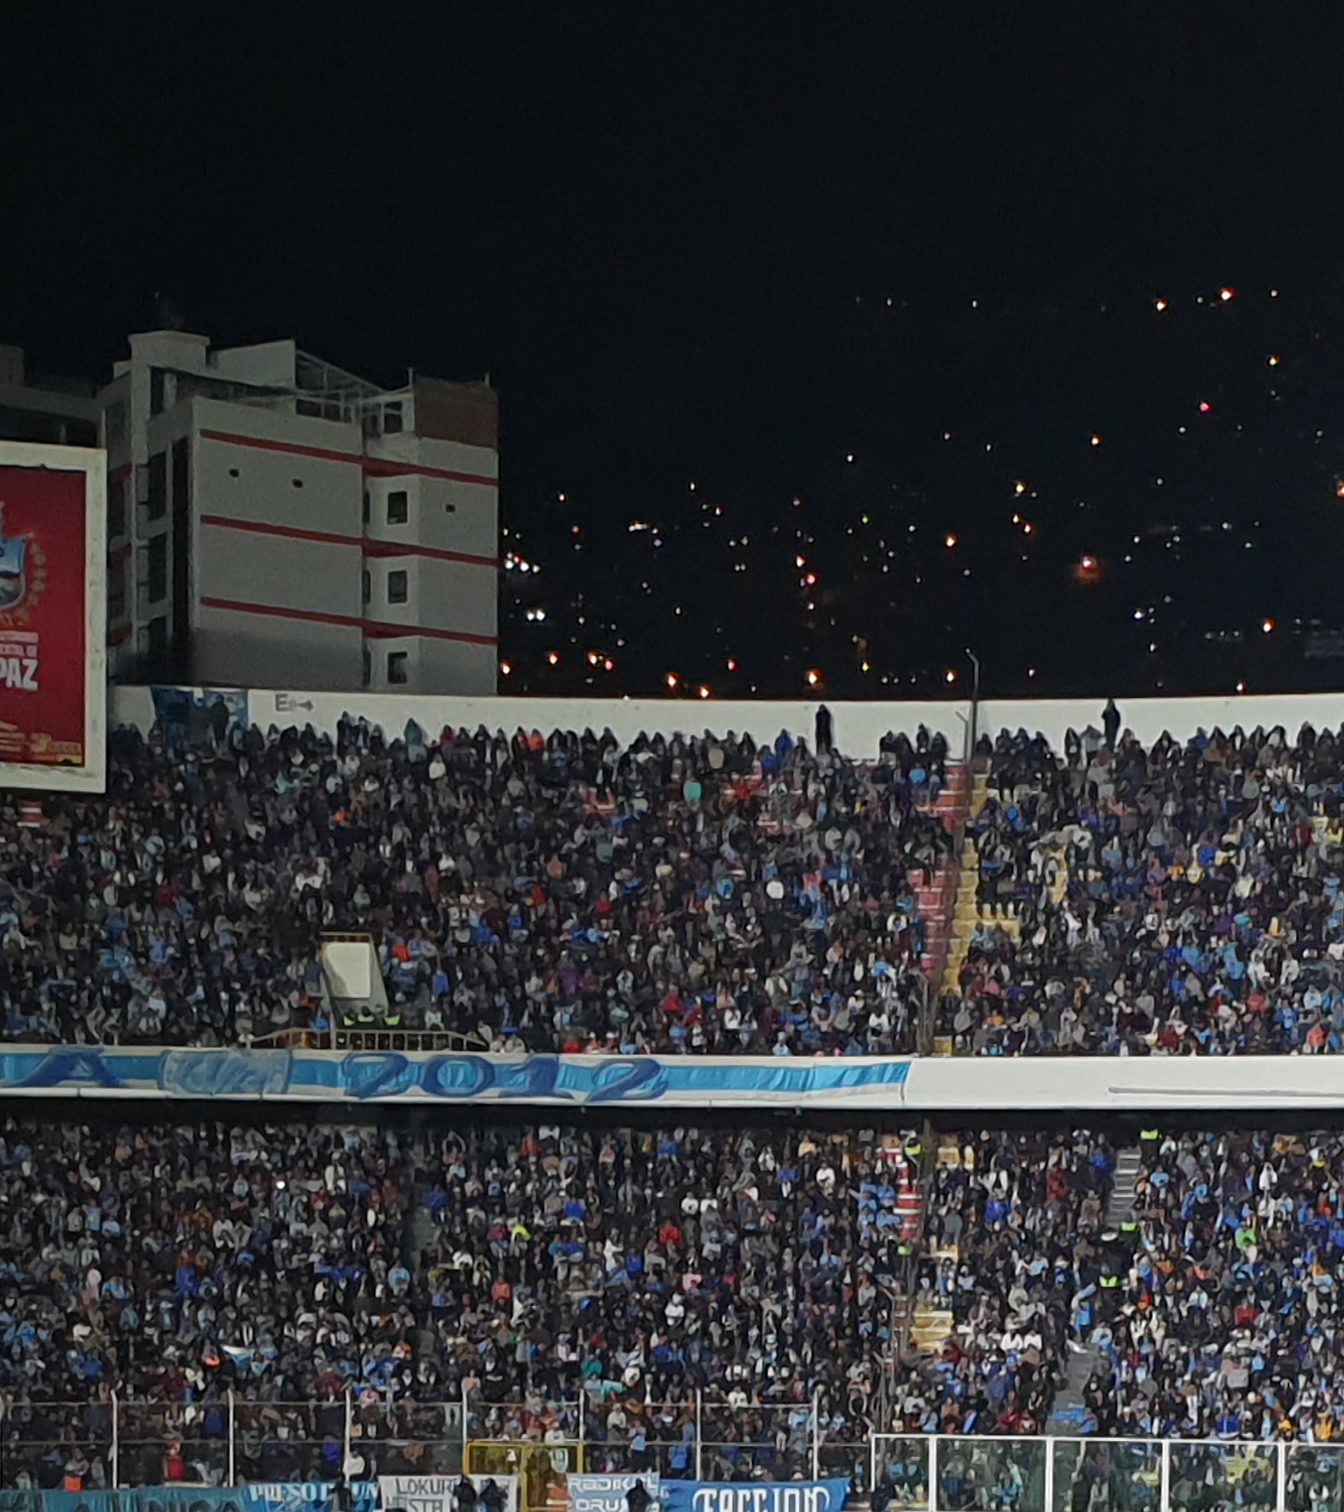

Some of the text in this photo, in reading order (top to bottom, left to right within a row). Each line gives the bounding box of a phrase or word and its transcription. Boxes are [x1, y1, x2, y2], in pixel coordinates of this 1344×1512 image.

[344, 1050, 667, 1100] 2012
[396, 1477, 457, 1496] LOKUR
[569, 1475, 659, 1494] RADIKL
